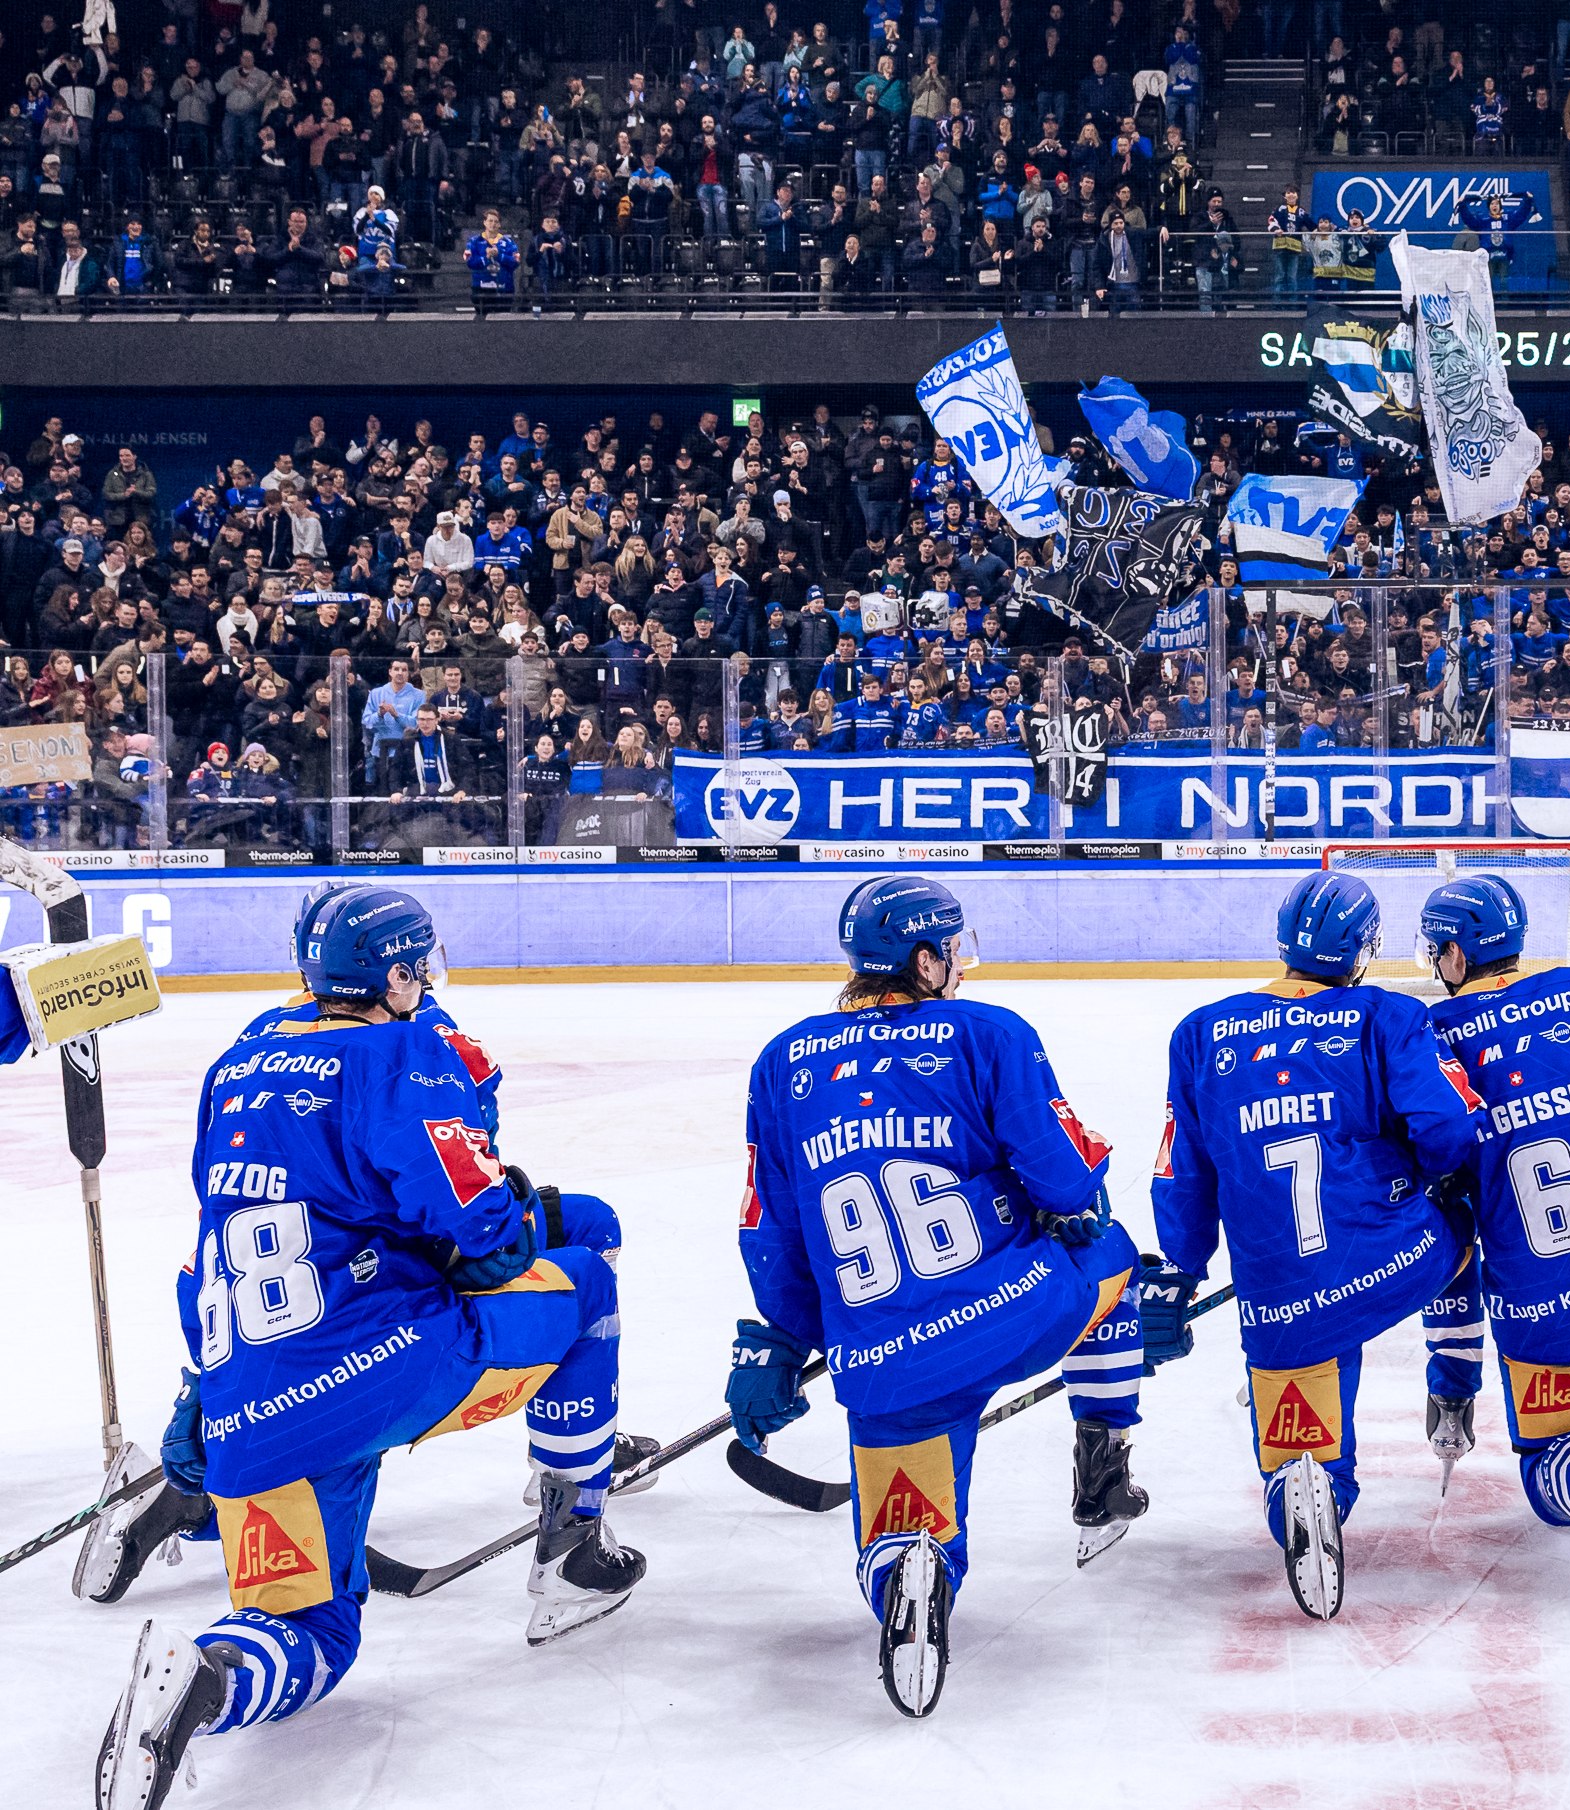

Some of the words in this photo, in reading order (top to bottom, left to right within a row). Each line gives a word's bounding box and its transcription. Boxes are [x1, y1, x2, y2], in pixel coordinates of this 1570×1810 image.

[1336, 176, 1460, 225] OYM
[84, 431, 148, 445] N-ALLAN
[152, 431, 208, 445] JENSEN
[1337, 457, 1354, 466] EVZ
[745, 777, 761, 786] Zug
[710, 787, 794, 822] EVZ
[828, 776, 1120, 830] HERI
[249, 850, 314, 863] thermoplan
[449, 849, 514, 863] mycasino
[539, 848, 602, 862] mycasino
[639, 847, 698, 858] thermoplan
[824, 846, 885, 860] mycasino
[908, 846, 969, 859] mycasino
[1082, 844, 1140, 856] thermoplan
[312, 921, 327, 935] 68
[1479, 932, 1506, 945] CCM
[108, 957, 141, 972] SWISS
[863, 961, 892, 971] CCM
[1316, 953, 1342, 963] CCM
[36, 978, 69, 996] SECURITY
[72, 967, 106, 983] CYBER
[40, 969, 149, 1023] InfoGuard
[331, 985, 367, 995] CCM
[1213, 1009, 1280, 1042] Binelli
[1287, 1005, 1360, 1031] Group
[789, 1025, 863, 1063] Binelli
[869, 1021, 955, 1044] Group
[262, 1048, 342, 1082] Group
[1240, 1090, 1335, 1135] MORET
[802, 1107, 953, 1170] VOŽENÍLEK
[207, 1161, 288, 1201] RZOG
[1262, 1133, 1329, 1258] 7
[820, 1158, 983, 1308] 96
[197, 1200, 325, 1372] 68
[1257, 1298, 1312, 1326] Zuger
[1314, 1230, 1437, 1309] Kantonalbank
[848, 1333, 905, 1369] Zuger
[908, 1259, 1052, 1347] Kantonalbank
[1506, 1295, 1558, 1321] Zuger
[206, 1413, 243, 1442] Zuger
[244, 1325, 422, 1425] Kantonalbank
[1267, 1406, 1323, 1444] Sika
[239, 1523, 301, 1581] Sika
